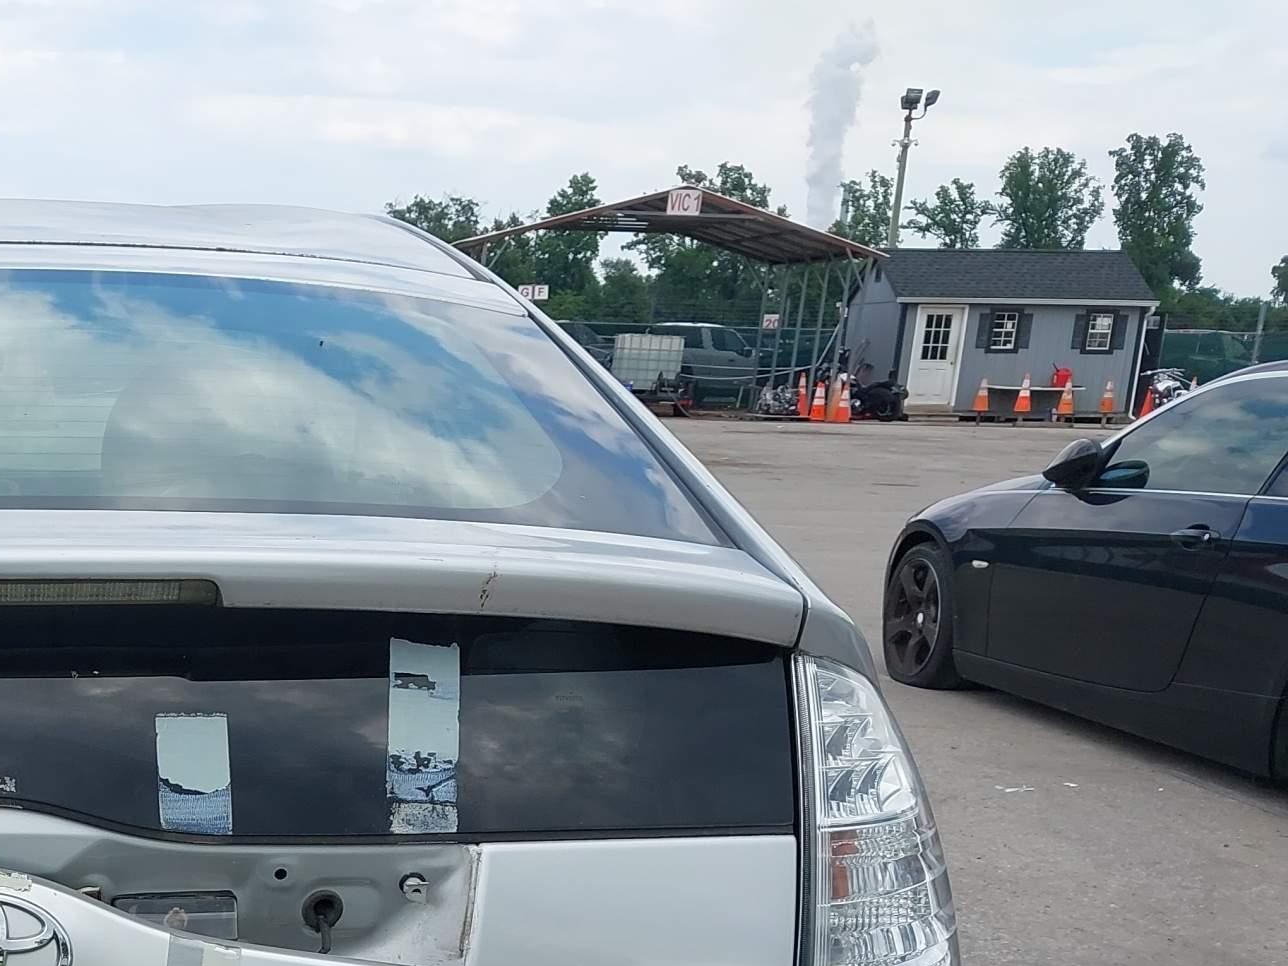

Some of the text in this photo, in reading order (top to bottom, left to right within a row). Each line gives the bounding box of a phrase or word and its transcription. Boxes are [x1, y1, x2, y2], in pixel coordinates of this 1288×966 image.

[670, 192, 701, 212] VIC 1
[520, 287, 530, 298] G
[537, 287, 545, 297] F
